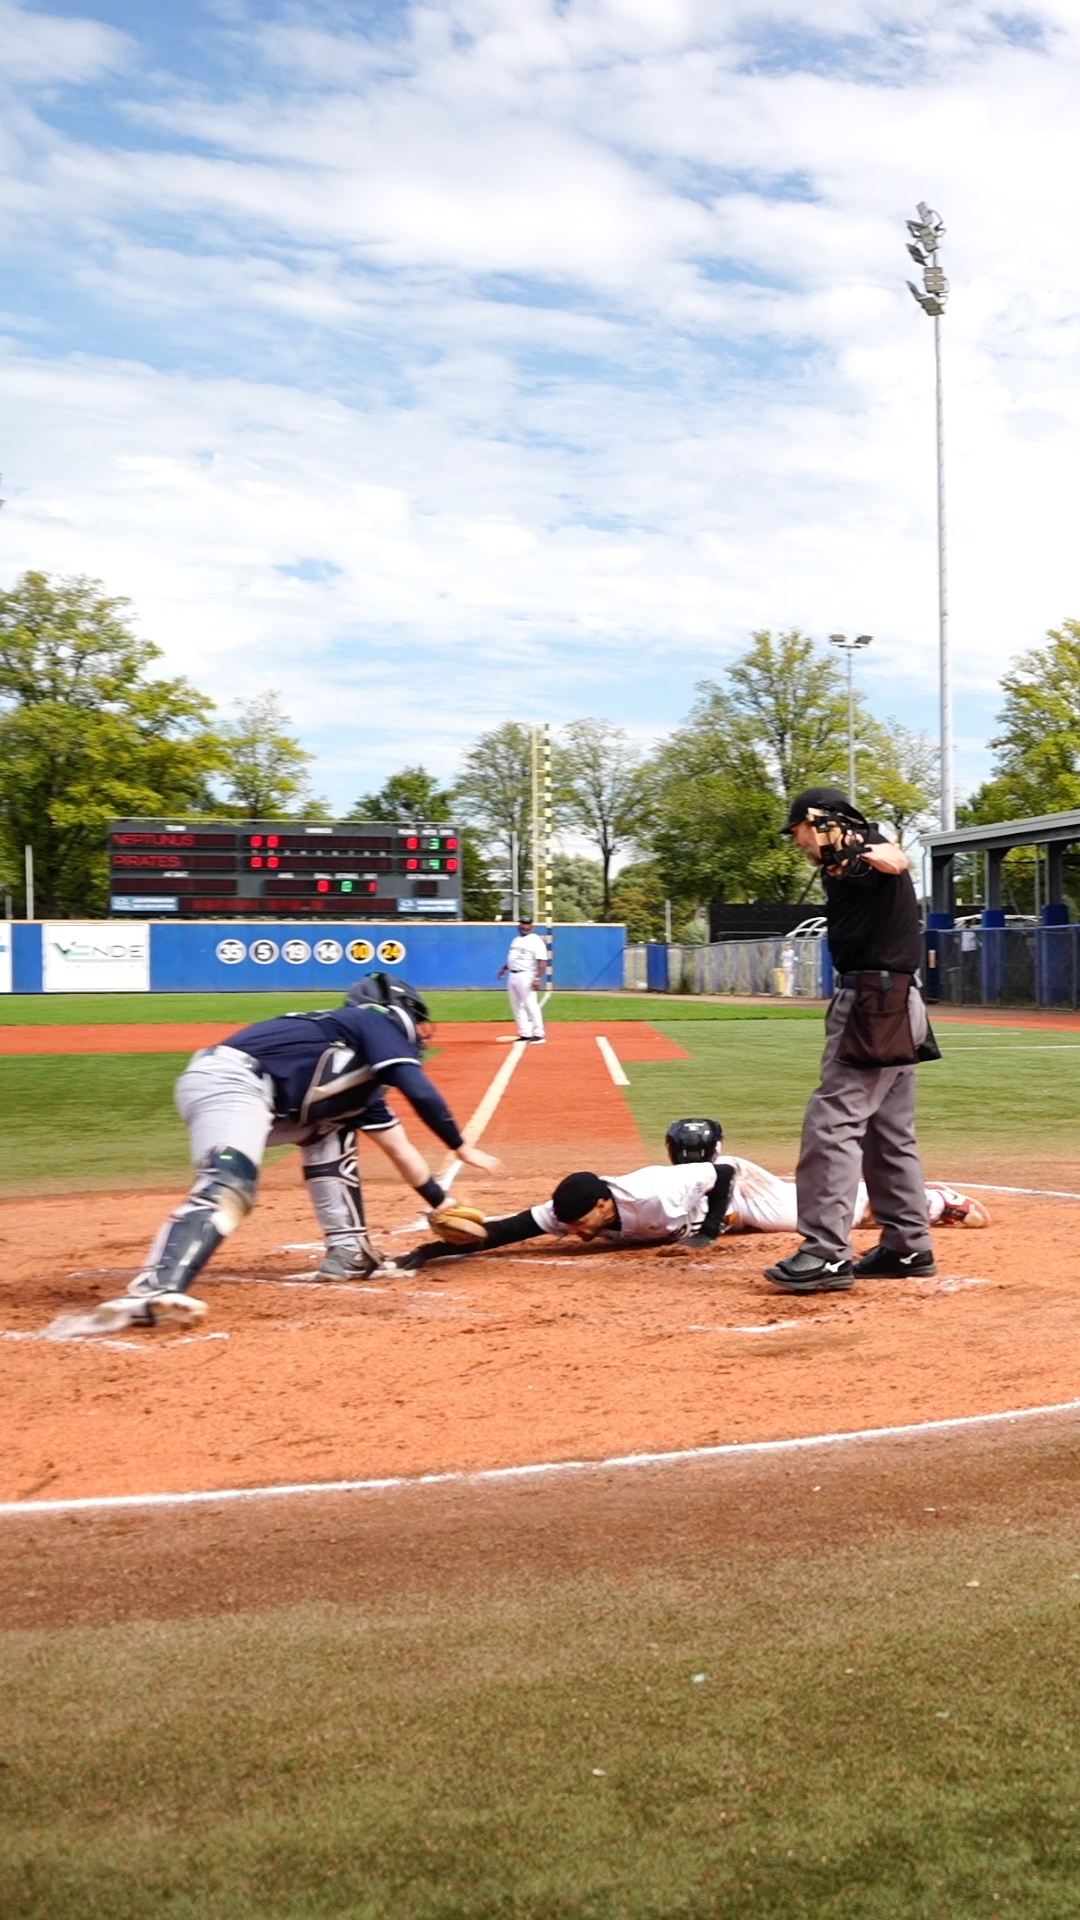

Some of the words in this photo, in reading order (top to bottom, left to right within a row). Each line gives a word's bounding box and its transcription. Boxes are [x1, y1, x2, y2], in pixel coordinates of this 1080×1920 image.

[112, 834, 195, 846] NEPTUNUS
[250, 835, 262, 847] 0
[267, 835, 279, 847] 0
[407, 837, 419, 849] 0
[428, 838, 440, 849] 3
[446, 838, 458, 849] 0
[112, 856, 181, 867] PIRATES
[251, 856, 262, 868] 0
[267, 856, 279, 868] 0
[407, 858, 418, 870] 0
[446, 859, 458, 870] 0
[220, 944, 242, 959] 35
[256, 944, 273, 959] 5
[317, 944, 338, 959] 14
[351, 944, 367, 959] 10
[382, 944, 402, 959] 24
